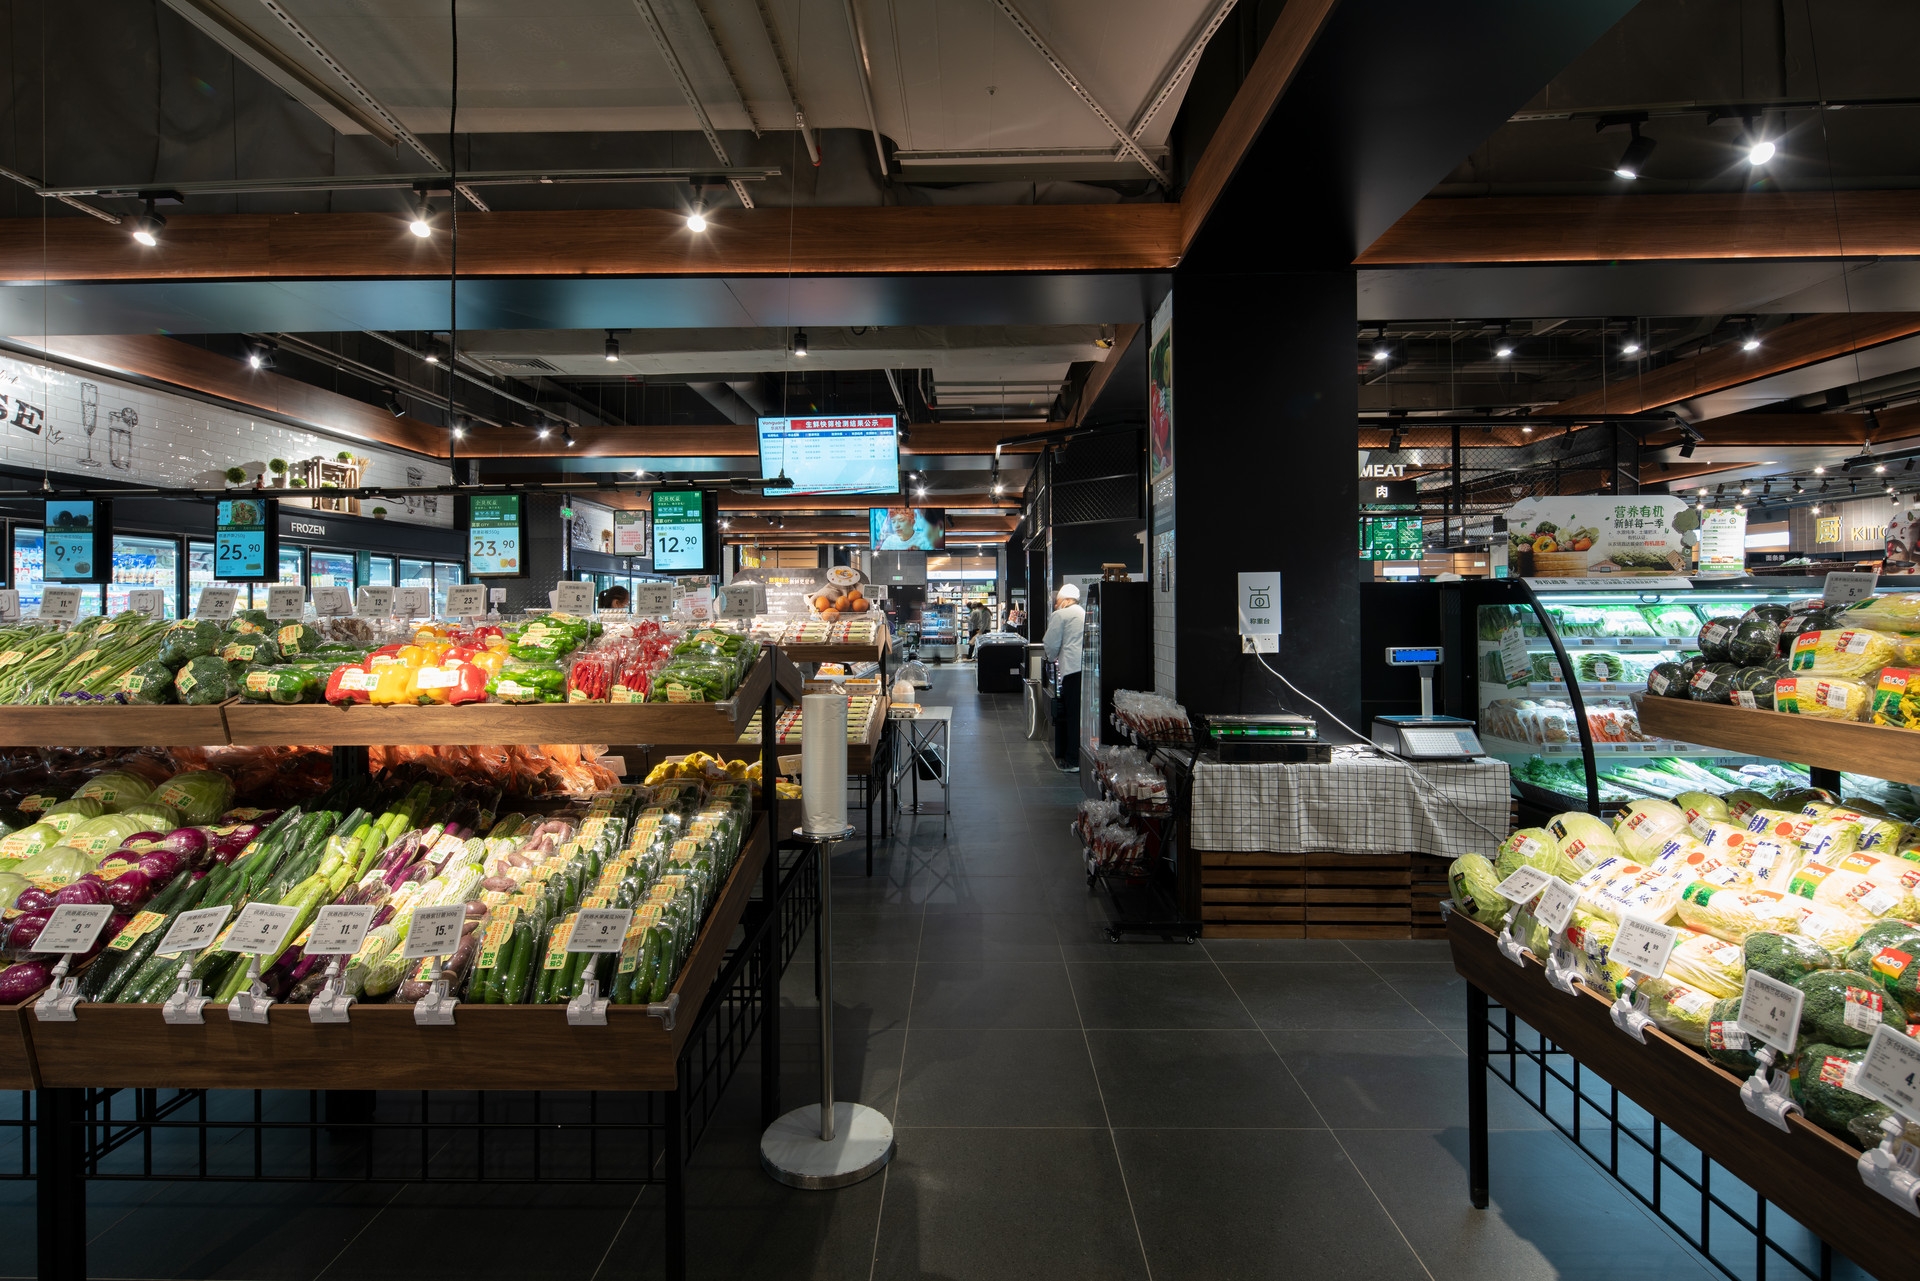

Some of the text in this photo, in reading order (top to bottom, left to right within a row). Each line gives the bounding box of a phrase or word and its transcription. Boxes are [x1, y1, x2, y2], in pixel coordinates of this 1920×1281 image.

[806, 420, 879, 428] 生鲜快筛检测结果公示
[1360, 464, 1407, 478] MEAT
[1376, 485, 1388, 498] 肉
[1614, 505, 1664, 518] 营养有机
[290, 522, 326, 536] FROZEN
[1614, 519, 1664, 528] 新鲜每一季
[1816, 516, 1842, 544] 厨
[474, 540, 514, 556] 23.90
[659, 536, 697, 553] 12.90
[55, 546, 83, 561] 9.99
[220, 544, 260, 560] 25.90
[73, 923, 91, 934] 9.99
[193, 923, 213, 933] 16.90
[261, 923, 278, 934] 9.99
[340, 924, 358, 935] 11.90
[435, 924, 454, 936] 15.90
[601, 926, 616, 934] 9.99
[1643, 942, 1659, 953] 4.99
[1770, 1006, 1786, 1021] 4.99
